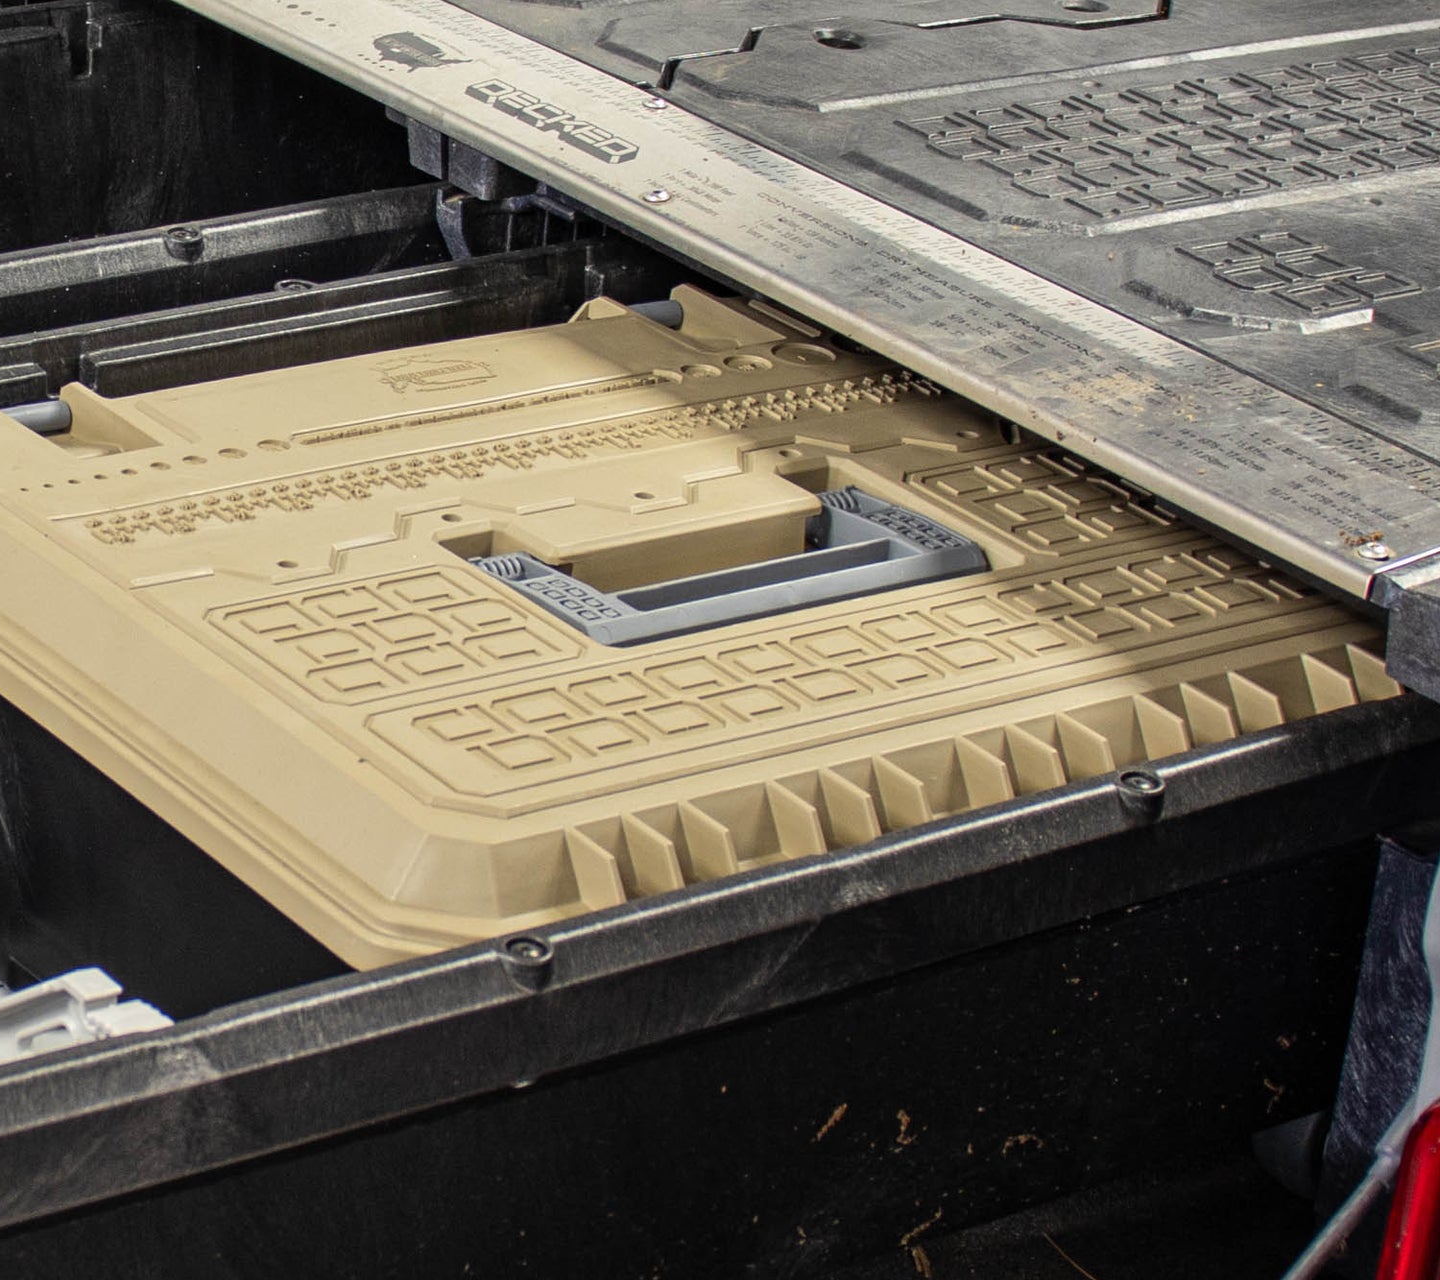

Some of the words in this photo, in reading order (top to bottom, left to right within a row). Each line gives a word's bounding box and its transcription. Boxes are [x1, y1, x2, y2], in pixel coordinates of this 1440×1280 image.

[464, 78, 640, 165] DECKED
[756, 191, 868, 247] CONVERSIONS
[911, 266, 997, 310] MEASURE
